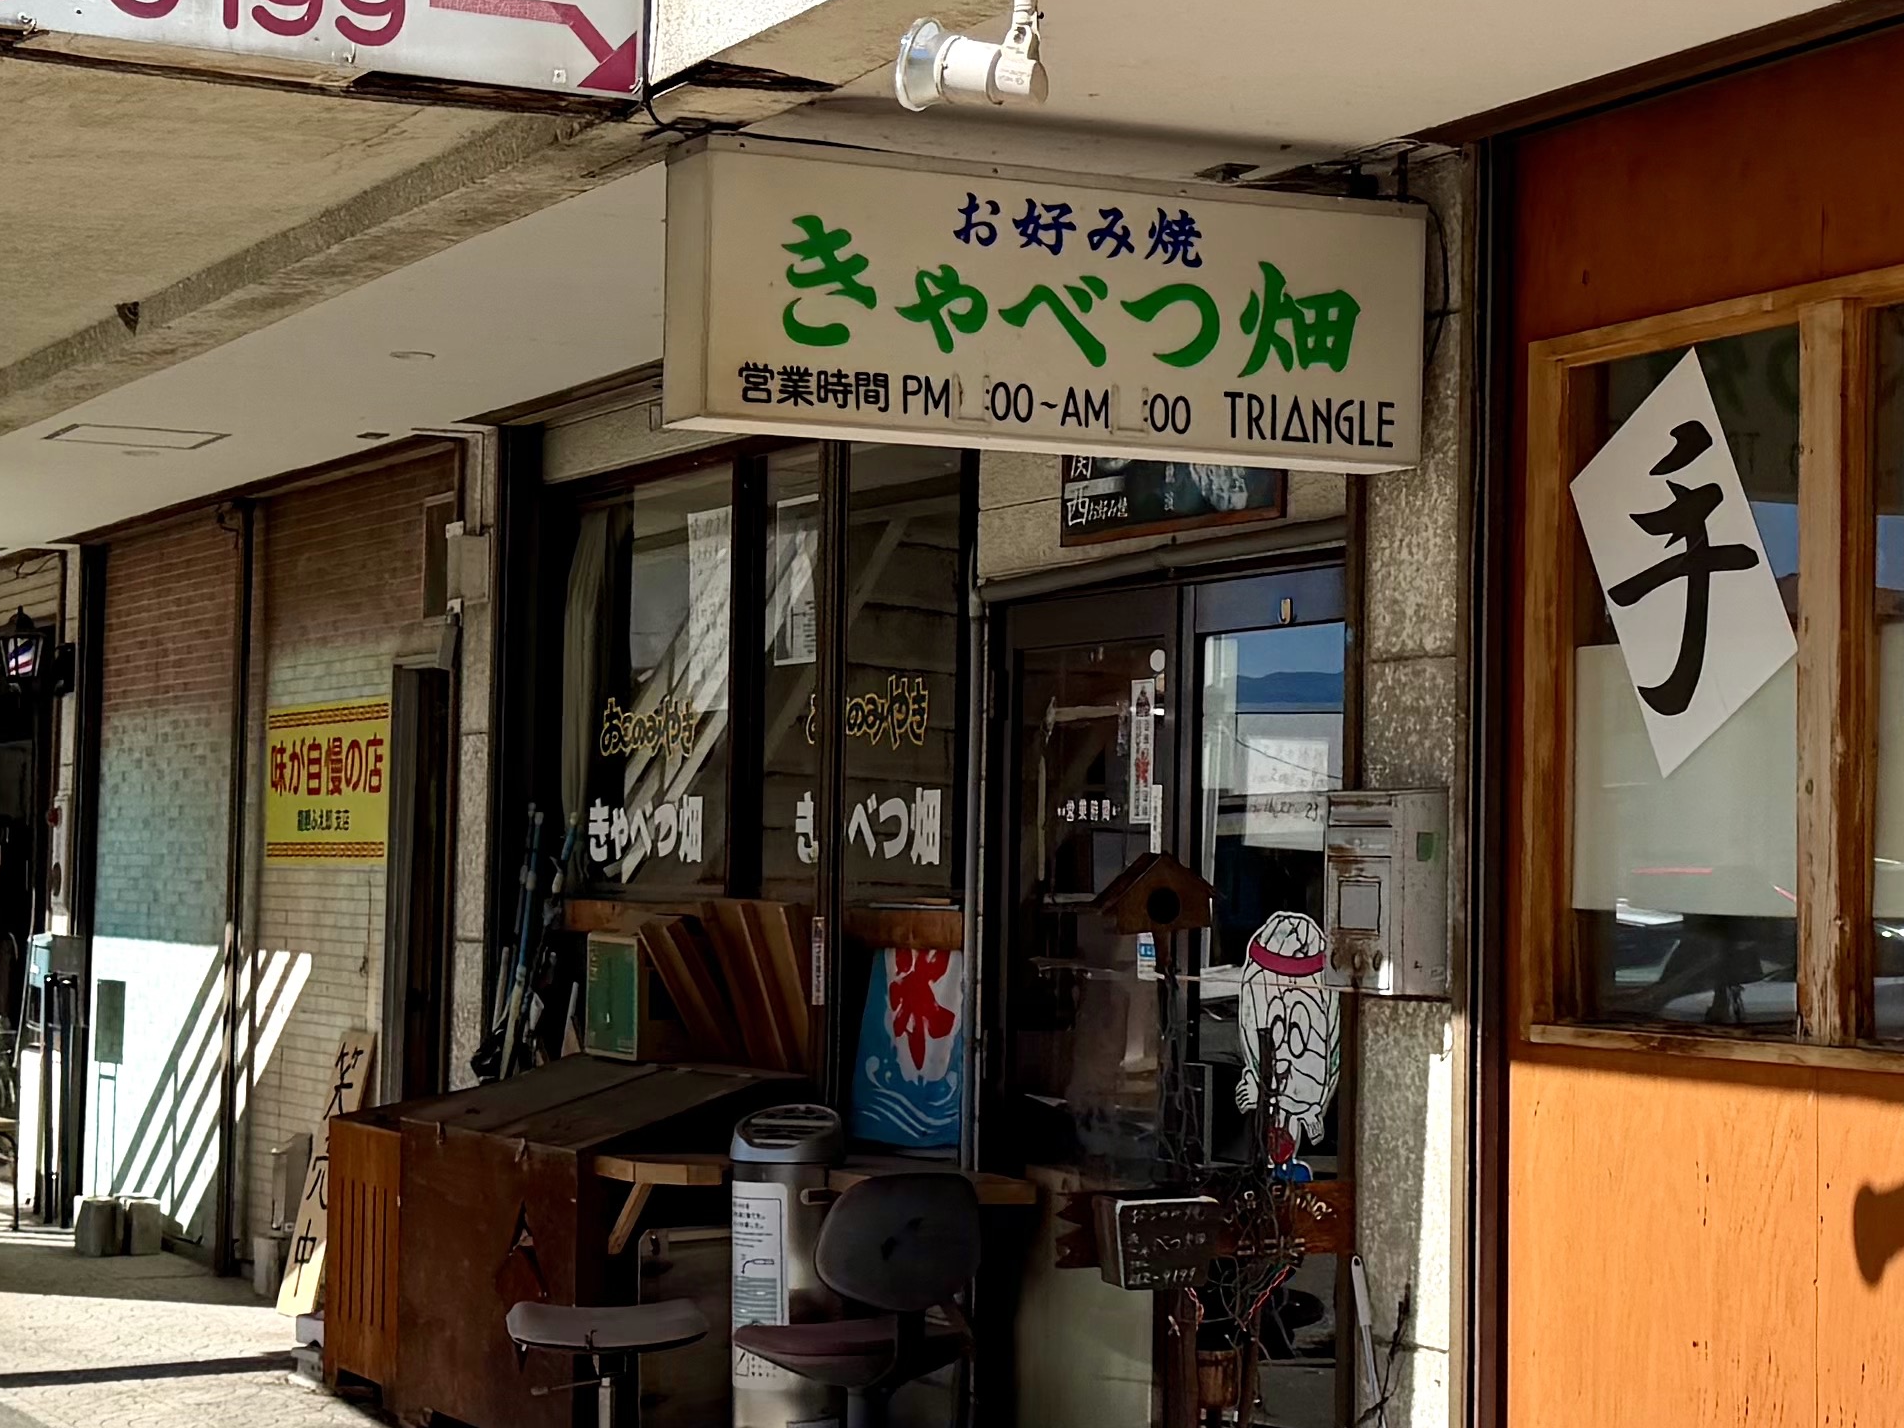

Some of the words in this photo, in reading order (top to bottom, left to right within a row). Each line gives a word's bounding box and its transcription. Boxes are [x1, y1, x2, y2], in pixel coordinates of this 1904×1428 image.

[953, 191, 1203, 268] お好み焼
[737, 361, 890, 413] 営業時間
[1223, 389, 1396, 448] TRIANGLE
[271, 733, 384, 796] 味が自慢の店
[796, 787, 942, 865] きべつ畑
